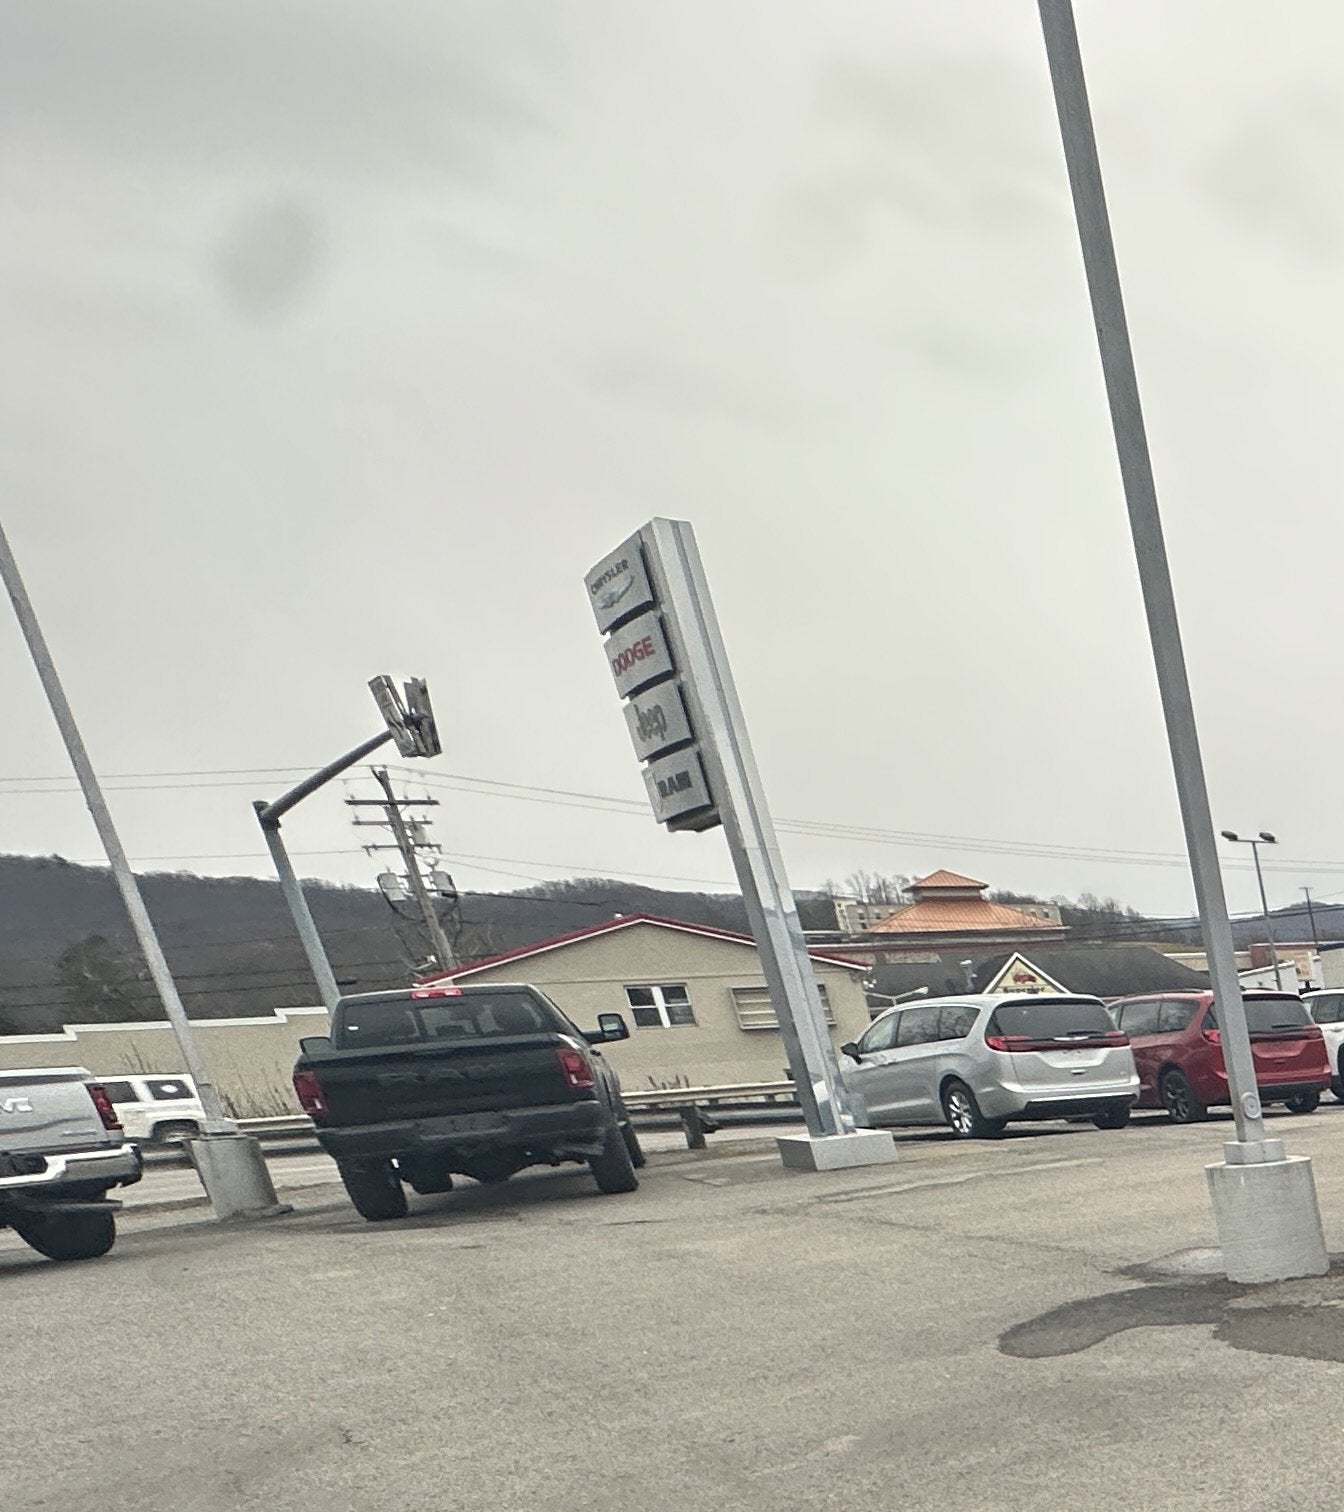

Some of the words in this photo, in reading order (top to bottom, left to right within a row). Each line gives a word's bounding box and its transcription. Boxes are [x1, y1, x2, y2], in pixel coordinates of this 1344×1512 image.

[589, 558, 630, 595] CHRYSLER
[612, 635, 655, 678] DODGE
[632, 703, 669, 743] Jeep
[656, 770, 693, 799] RAM
